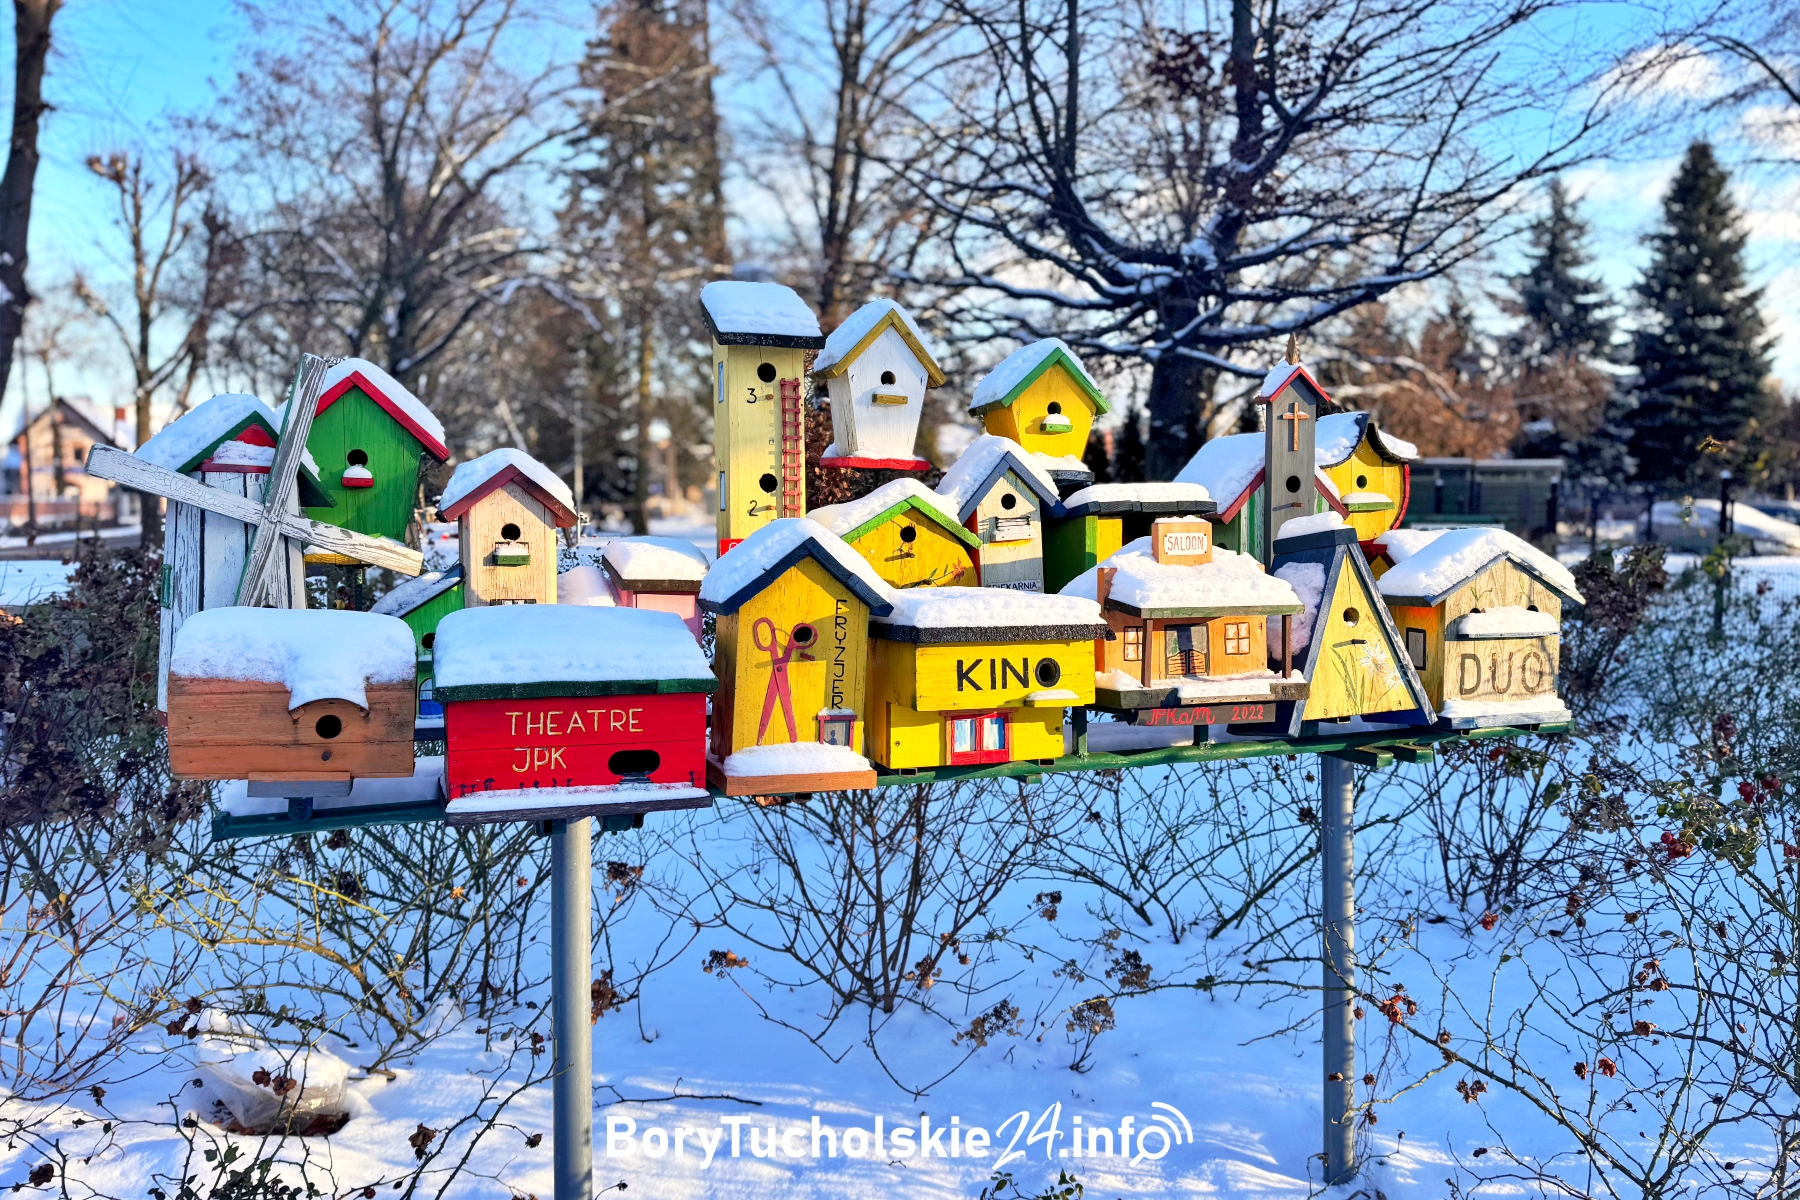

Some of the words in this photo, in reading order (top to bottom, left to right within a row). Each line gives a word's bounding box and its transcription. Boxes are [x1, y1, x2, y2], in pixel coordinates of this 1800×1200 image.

[746, 388, 757, 403] 3
[748, 500, 758, 516] 2
[1167, 535, 1204, 551] SALOON
[831, 599, 848, 709] FRYZJER
[956, 657, 1061, 691] KINO
[1460, 651, 1544, 695] DUO
[505, 707, 644, 736] THEATRE
[1231, 705, 1264, 721] 2022
[512, 746, 567, 773] JPK
